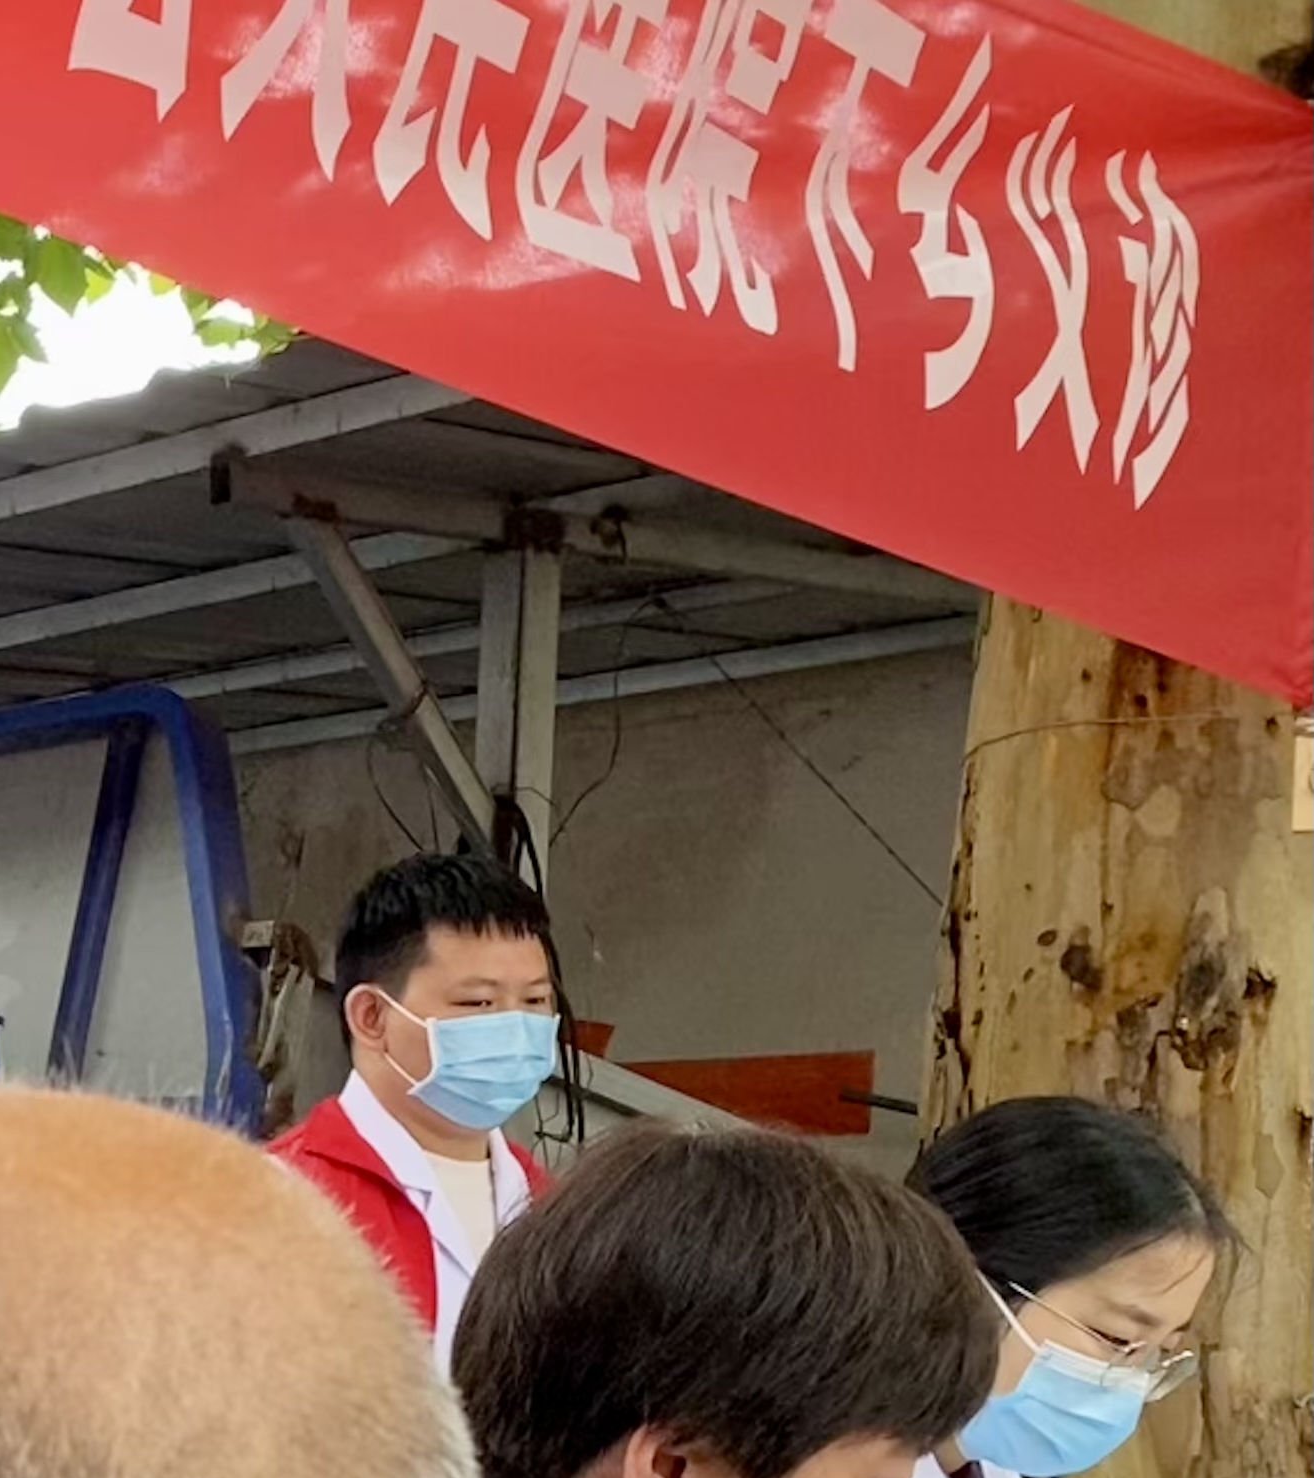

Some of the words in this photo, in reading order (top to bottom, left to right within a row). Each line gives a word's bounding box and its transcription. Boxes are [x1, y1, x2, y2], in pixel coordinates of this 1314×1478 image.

[67, 0, 1200, 511] 民医院下乡义诊
